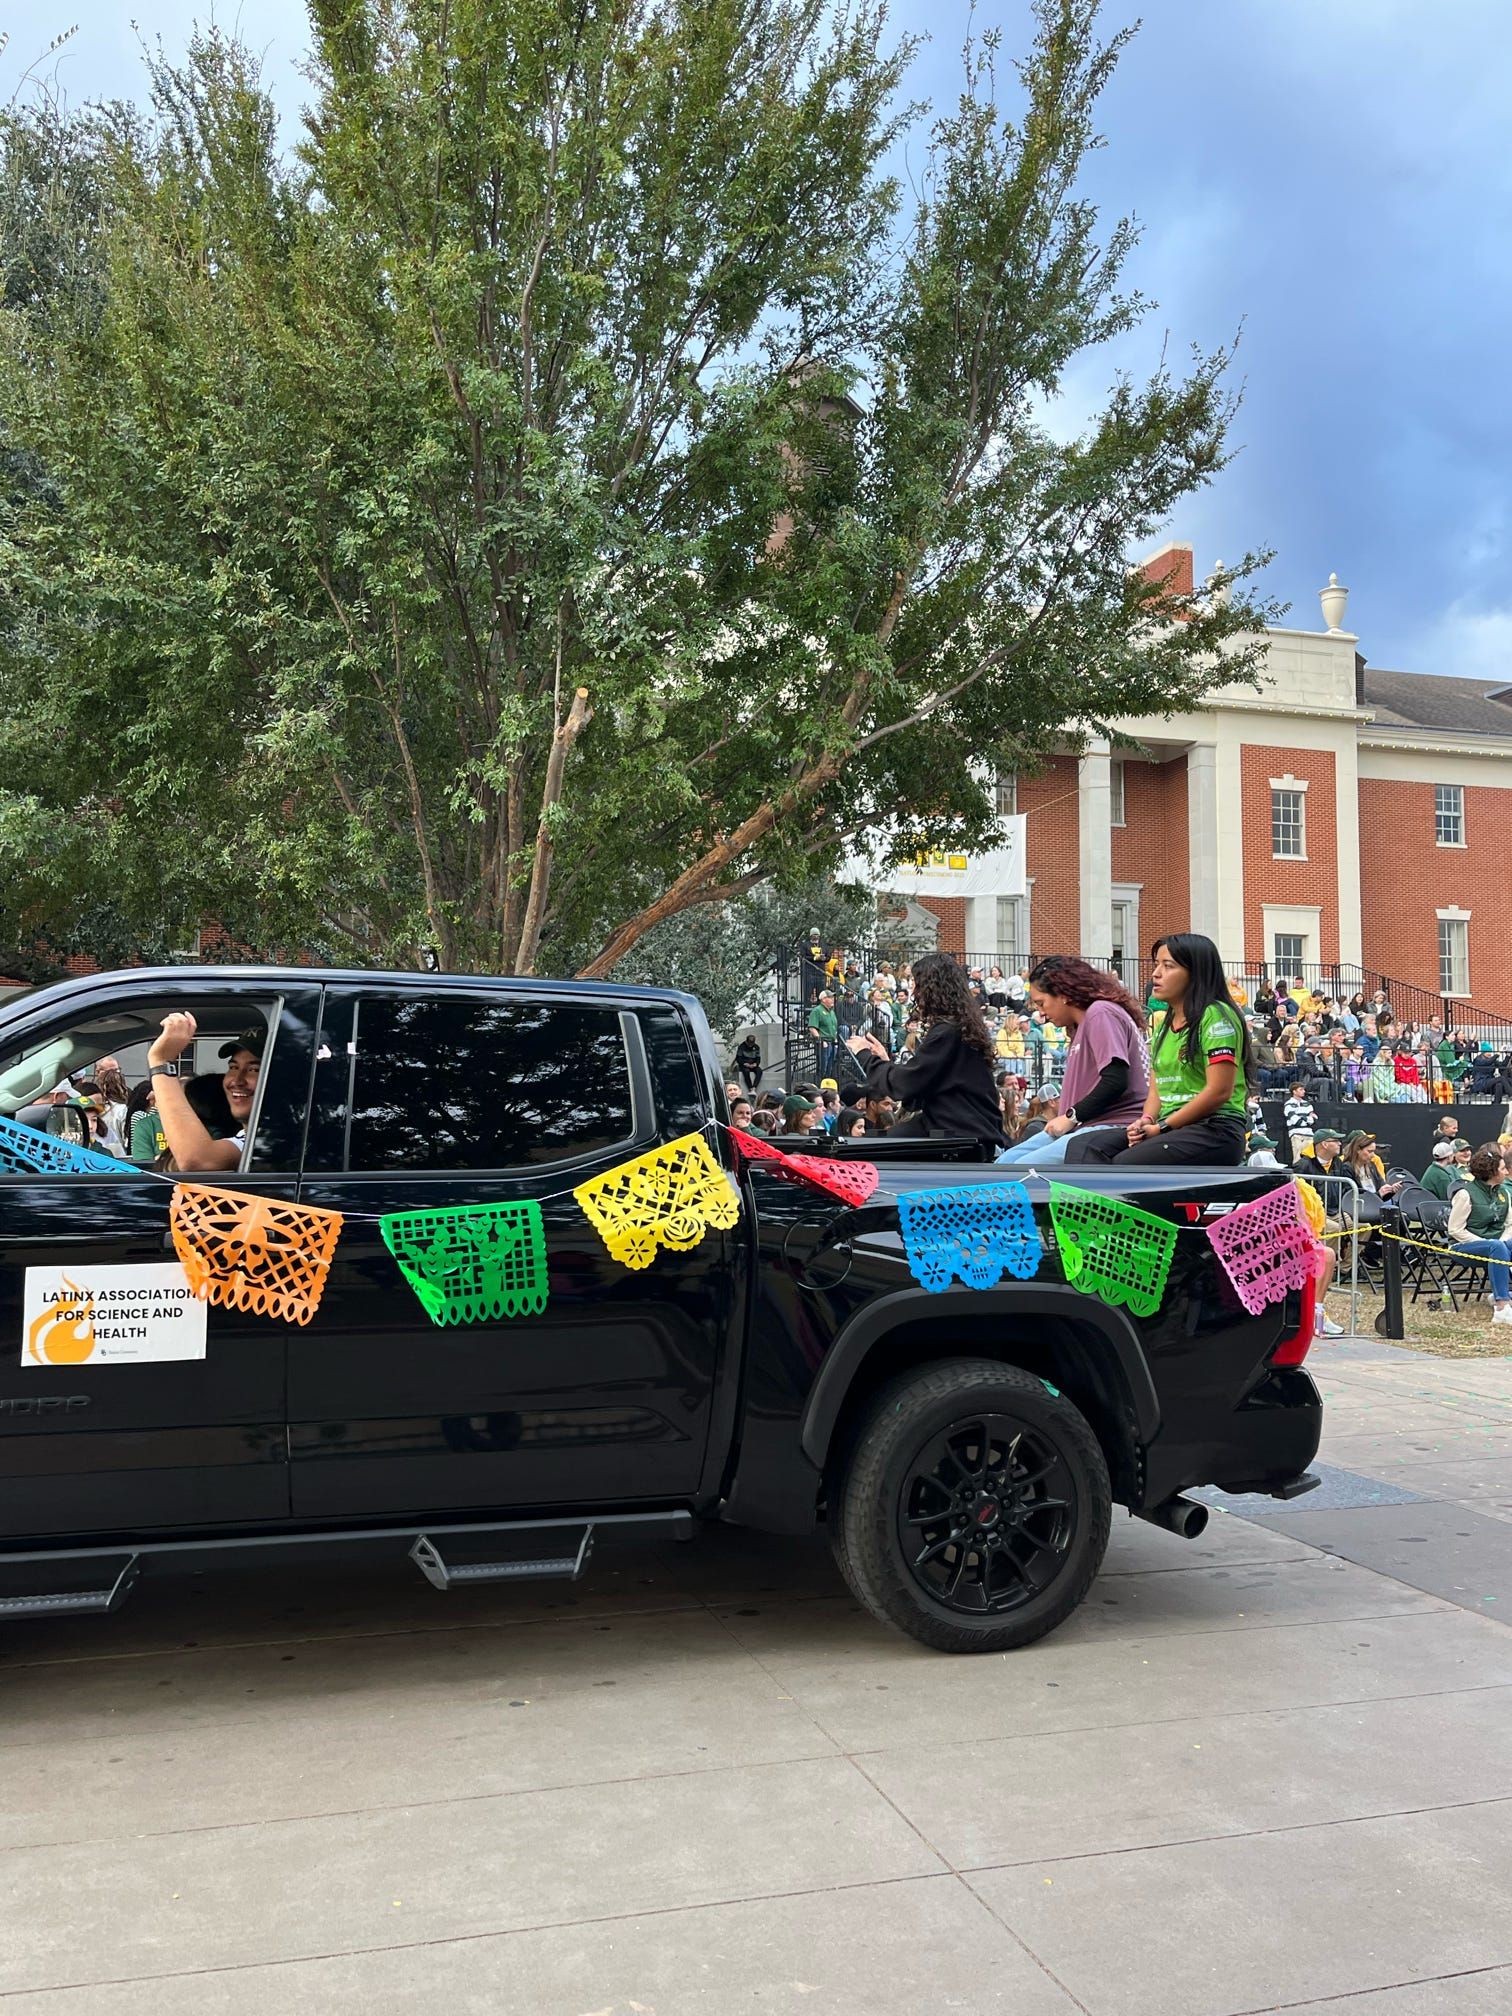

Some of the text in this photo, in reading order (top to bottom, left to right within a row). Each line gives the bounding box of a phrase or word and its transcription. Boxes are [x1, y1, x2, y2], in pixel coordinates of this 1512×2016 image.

[43, 1288, 196, 1303] LATINX ASSOCIATION
[56, 1307, 184, 1321] FOR SCIENCE AND
[93, 1327, 147, 1339] HEALTH
